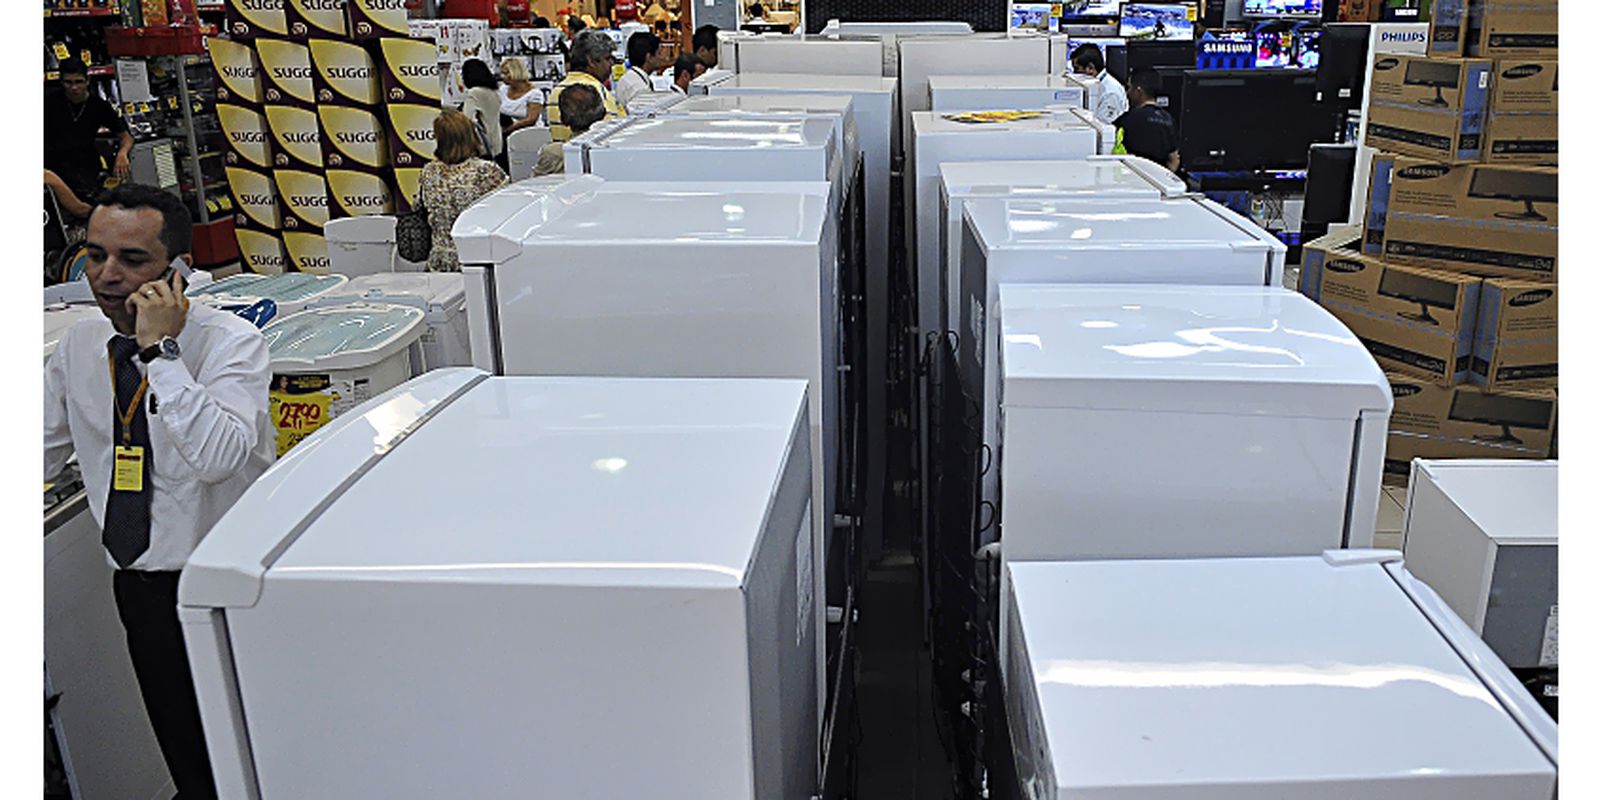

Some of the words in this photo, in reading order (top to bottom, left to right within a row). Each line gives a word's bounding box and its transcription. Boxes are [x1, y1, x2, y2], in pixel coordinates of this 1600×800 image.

[1382, 32, 1426, 42] PHILIPS
[1203, 43, 1253, 53] SAMSUNG
[300, 257, 330, 268] SUG
